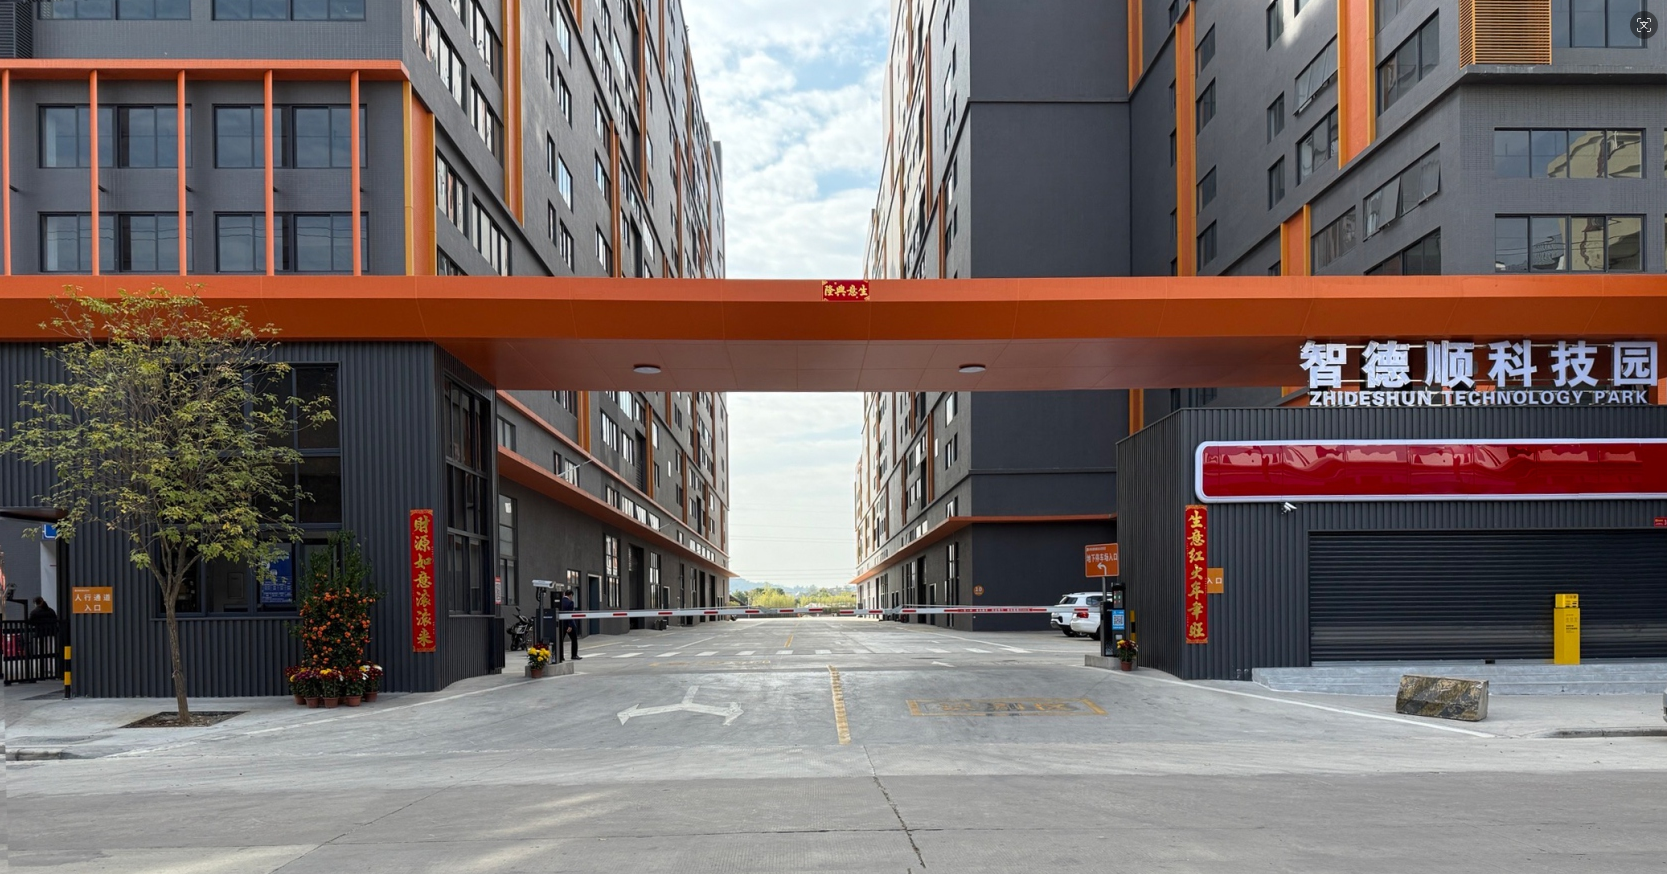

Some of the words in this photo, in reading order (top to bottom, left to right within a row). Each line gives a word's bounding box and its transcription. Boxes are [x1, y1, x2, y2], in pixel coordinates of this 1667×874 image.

[1300, 340, 1659, 389] 智德顺科技园
[1309, 390, 1432, 406] ZHIDESHUN
[1443, 390, 1584, 406] TECHNOLOGY
[1594, 390, 1648, 404] PARK
[1086, 552, 1118, 563] 地下停车场入口
[74, 593, 111, 602] 人行通道
[84, 604, 101, 612] 入口
